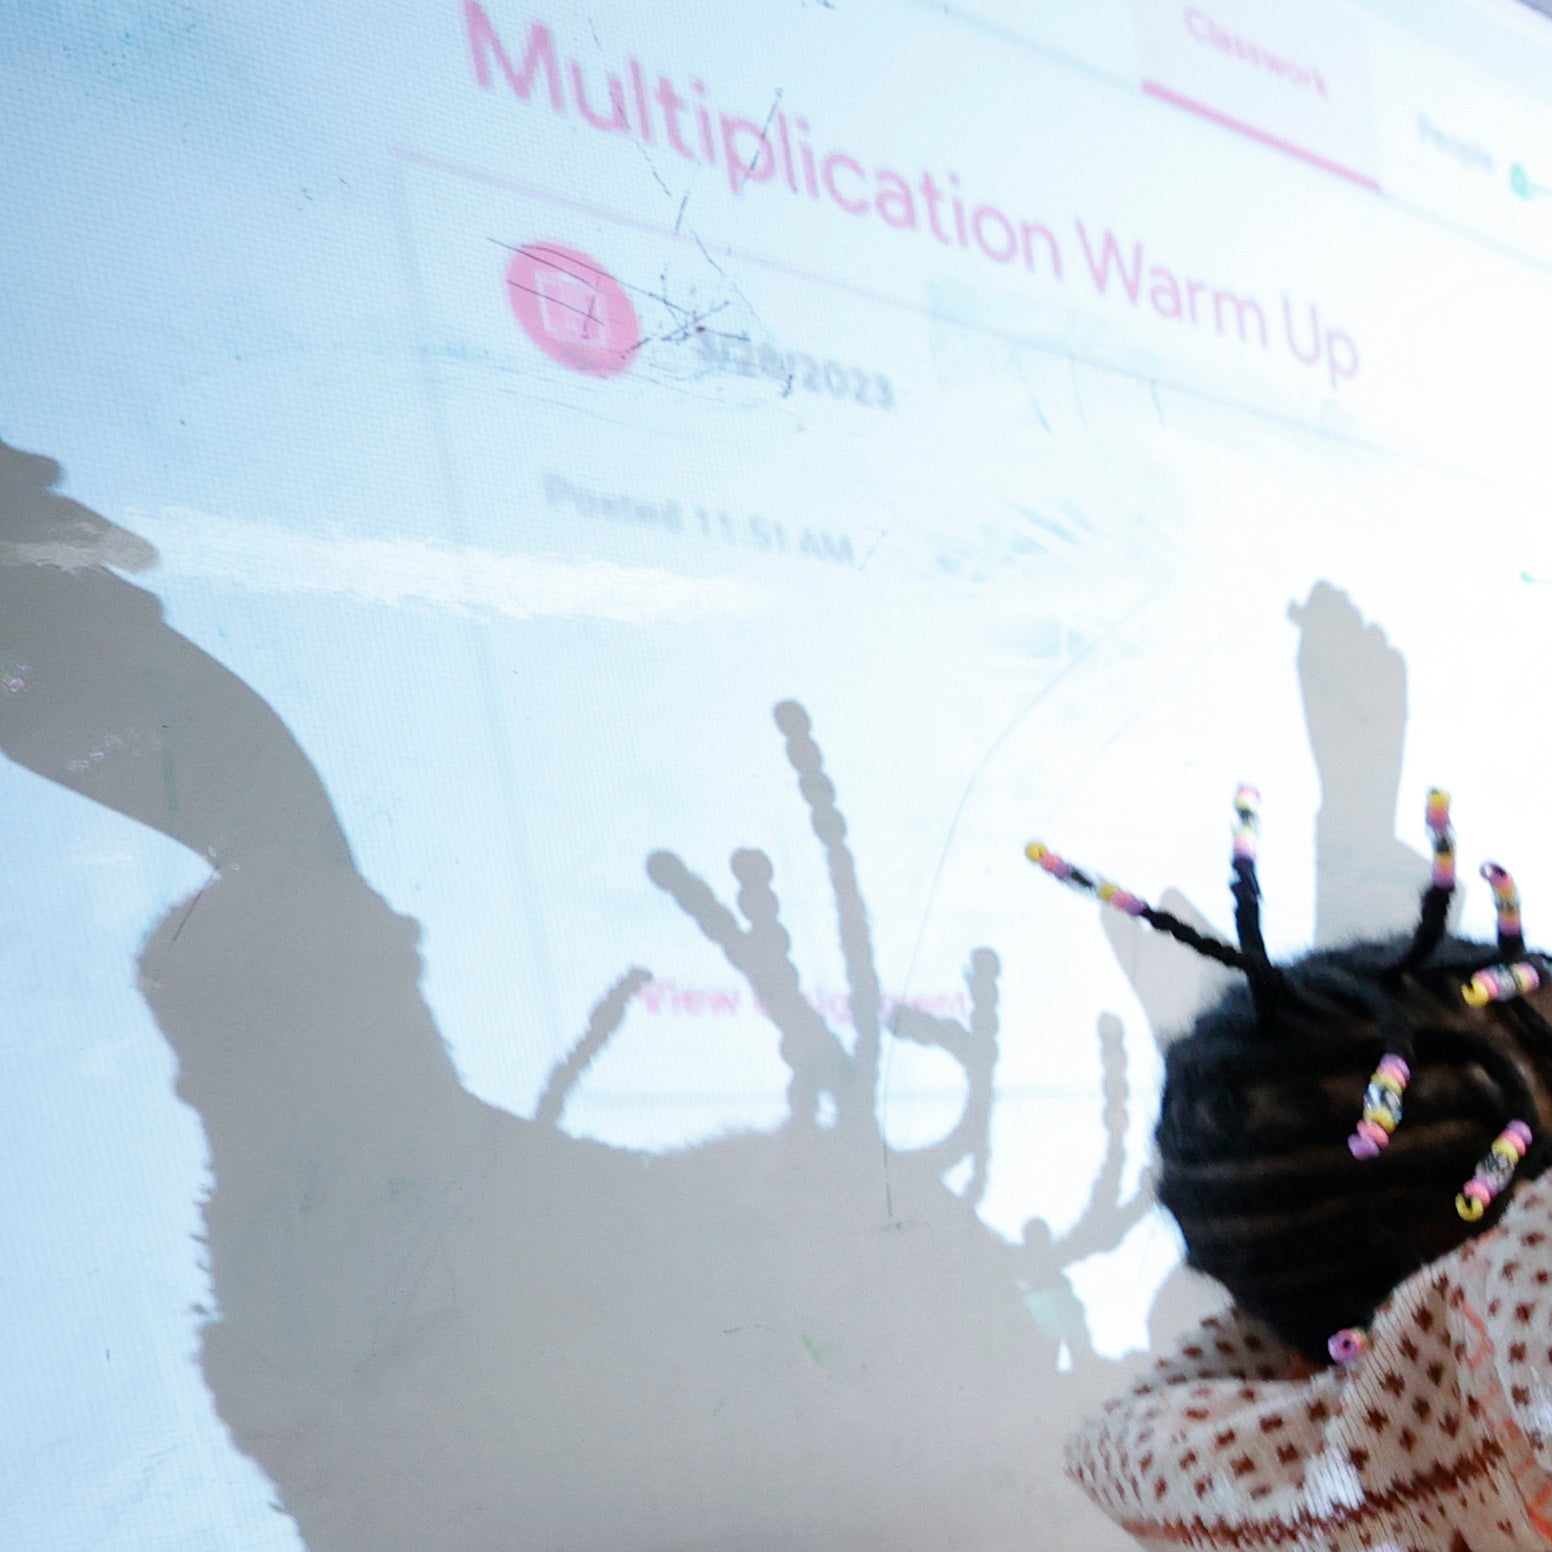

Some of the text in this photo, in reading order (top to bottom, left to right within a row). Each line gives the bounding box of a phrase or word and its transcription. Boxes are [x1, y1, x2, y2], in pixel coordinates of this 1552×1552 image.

[1184, 5, 1329, 99] Classwork
[460, 0, 1361, 390] Multiplication Warm Up
